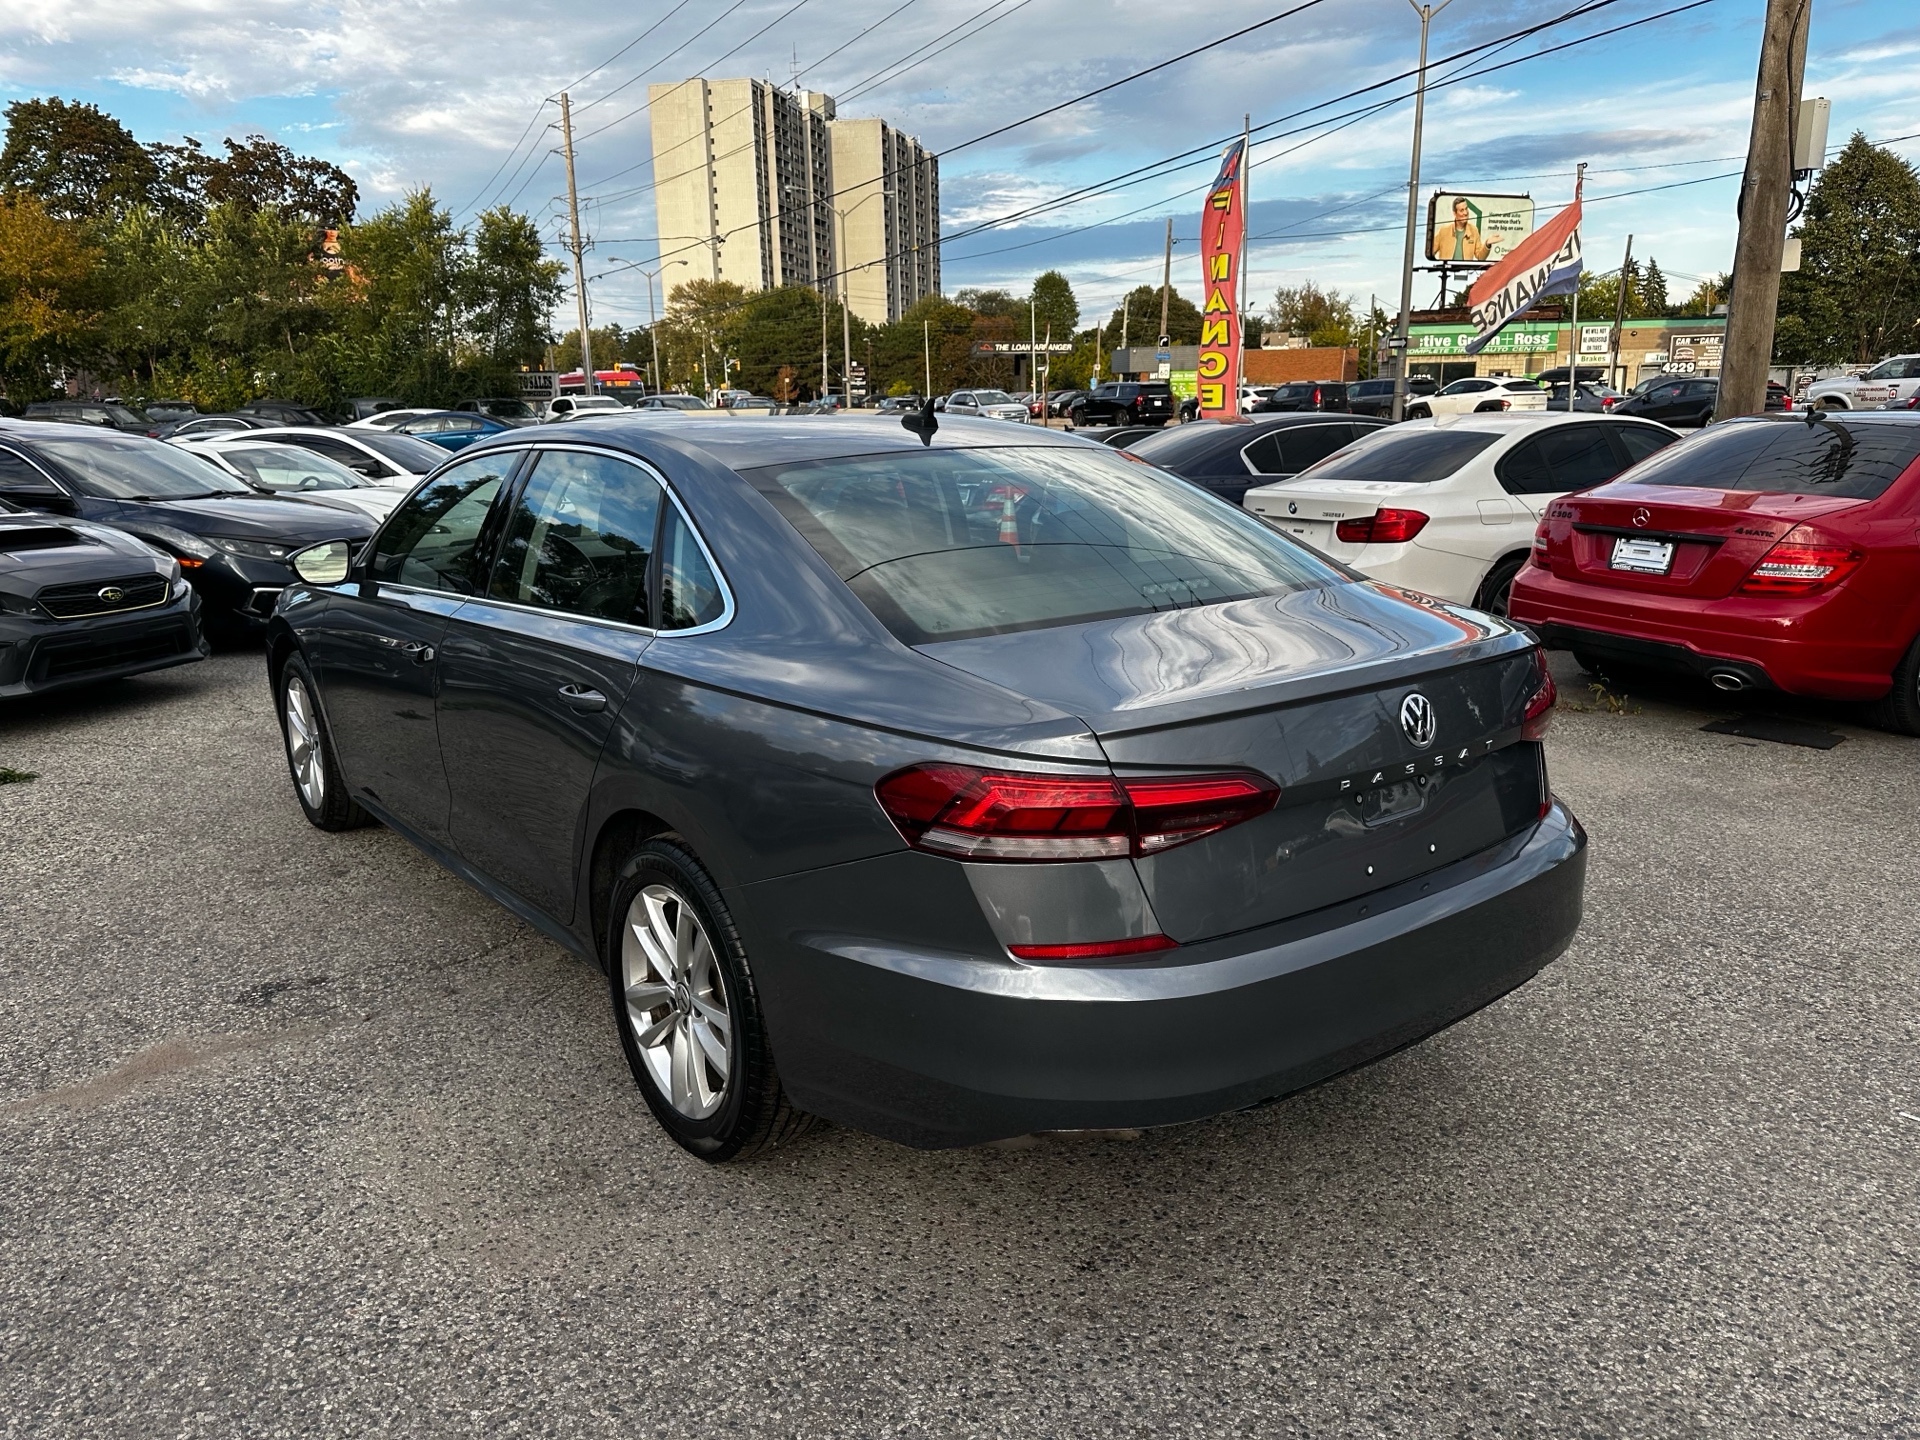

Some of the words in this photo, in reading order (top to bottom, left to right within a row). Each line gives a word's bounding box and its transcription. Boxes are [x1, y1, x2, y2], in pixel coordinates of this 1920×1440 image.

[1420, 334, 1452, 348] tive
[1457, 334, 1500, 348] Grn
[1675, 337, 1691, 346] CAR
[1700, 336, 1720, 345] CARE
[1662, 362, 1694, 373] 4229
[529, 375, 552, 390] SALES
[1340, 739, 1493, 791] PASSAT
